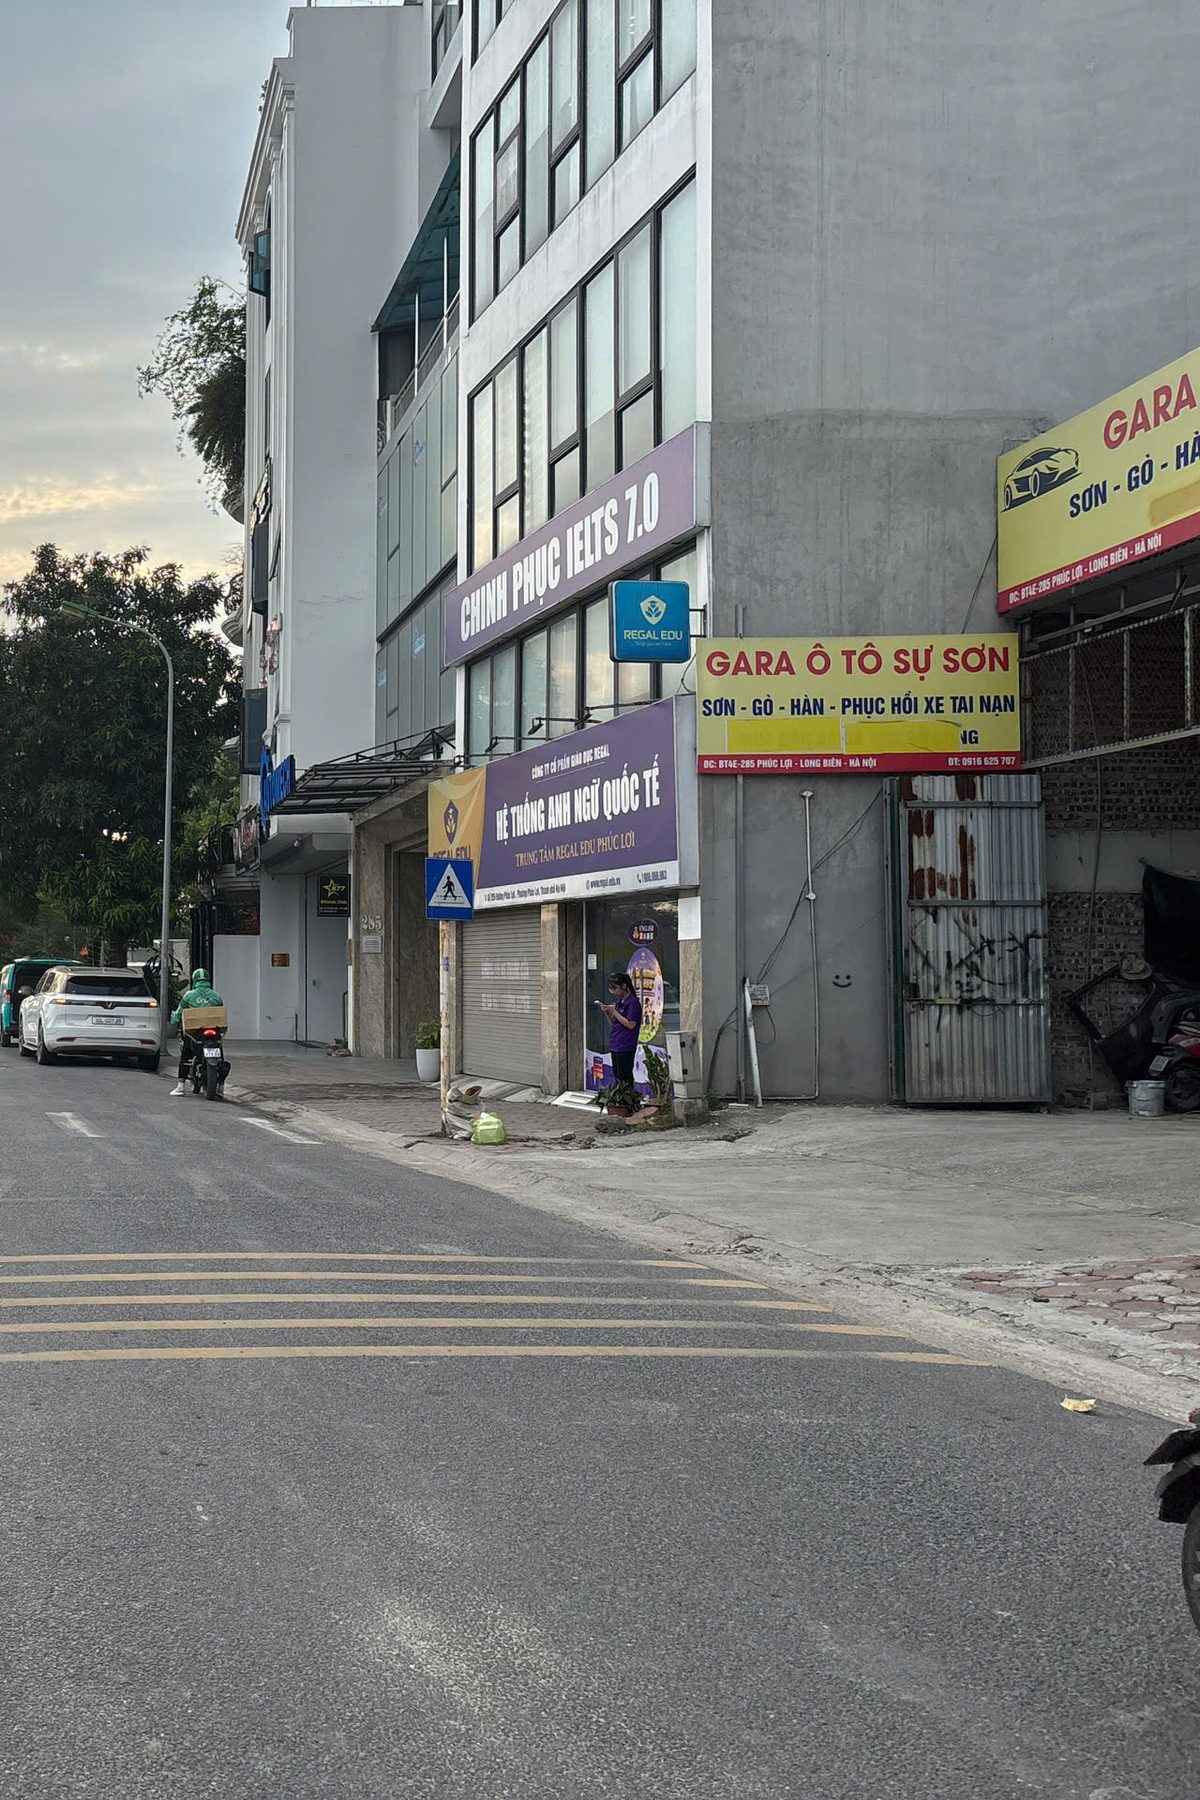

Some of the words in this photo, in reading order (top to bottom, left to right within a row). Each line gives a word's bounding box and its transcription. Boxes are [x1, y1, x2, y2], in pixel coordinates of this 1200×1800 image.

[1104, 373, 1197, 450] GARA
[1069, 480, 1107, 518] SƠN
[1127, 453, 1154, 492] GÒ
[460, 570, 508, 642] CHINH
[512, 536, 561, 611] PHỤC
[565, 497, 619, 580] IELTS
[624, 471, 660, 544] 7.0
[1052, 570, 1071, 588] PHÚC
[1088, 554, 1108, 574] LONG
[1110, 546, 1128, 566] BIÊN
[1134, 538, 1146, 556] HÀ
[623, 629, 659, 640] REGAL
[660, 630, 683, 641] EDU
[705, 650, 796, 677] GARA
[806, 642, 831, 676] Ô
[841, 641, 883, 675] TÔ
[893, 644, 934, 682] SỰ
[942, 643, 1010, 673] SƠN
[702, 697, 736, 717] SƠN
[752, 694, 774, 716] GÒ
[790, 694, 824, 716] HÀN
[841, 697, 885, 719] PHỤC
[923, 696, 945, 714] XE
[950, 695, 974, 714] TAI
[979, 694, 1015, 717] NẠN
[594, 744, 610, 760] REGAL
[718, 759, 755, 769] BT4E-285
[756, 757, 778, 769] PHÚC
[780, 758, 793, 770] LỢI
[800, 758, 821, 768] LONG
[822, 757, 842, 768] BIÊN
[849, 756, 861, 767] HÀ
[863, 756, 877, 769] NỘI
[962, 757, 982, 766] 0916
[984, 756, 999, 766] 625
[1000, 756, 1016, 765] 707
[496, 802, 508, 846] HỆ
[510, 791, 545, 838] THỐNG
[548, 790, 571, 830] ANH
[574, 777, 600, 823] NGỮ
[602, 763, 639, 821] QUỐC
[642, 754, 660, 808] TẾ
[515, 849, 538, 867] TRUNG
[556, 842, 579, 860] REGAL
[580, 839, 596, 856] EDU
[597, 831, 620, 853] PHÚC
[620, 830, 635, 851] LỢI
[362, 915, 382, 930] 285
